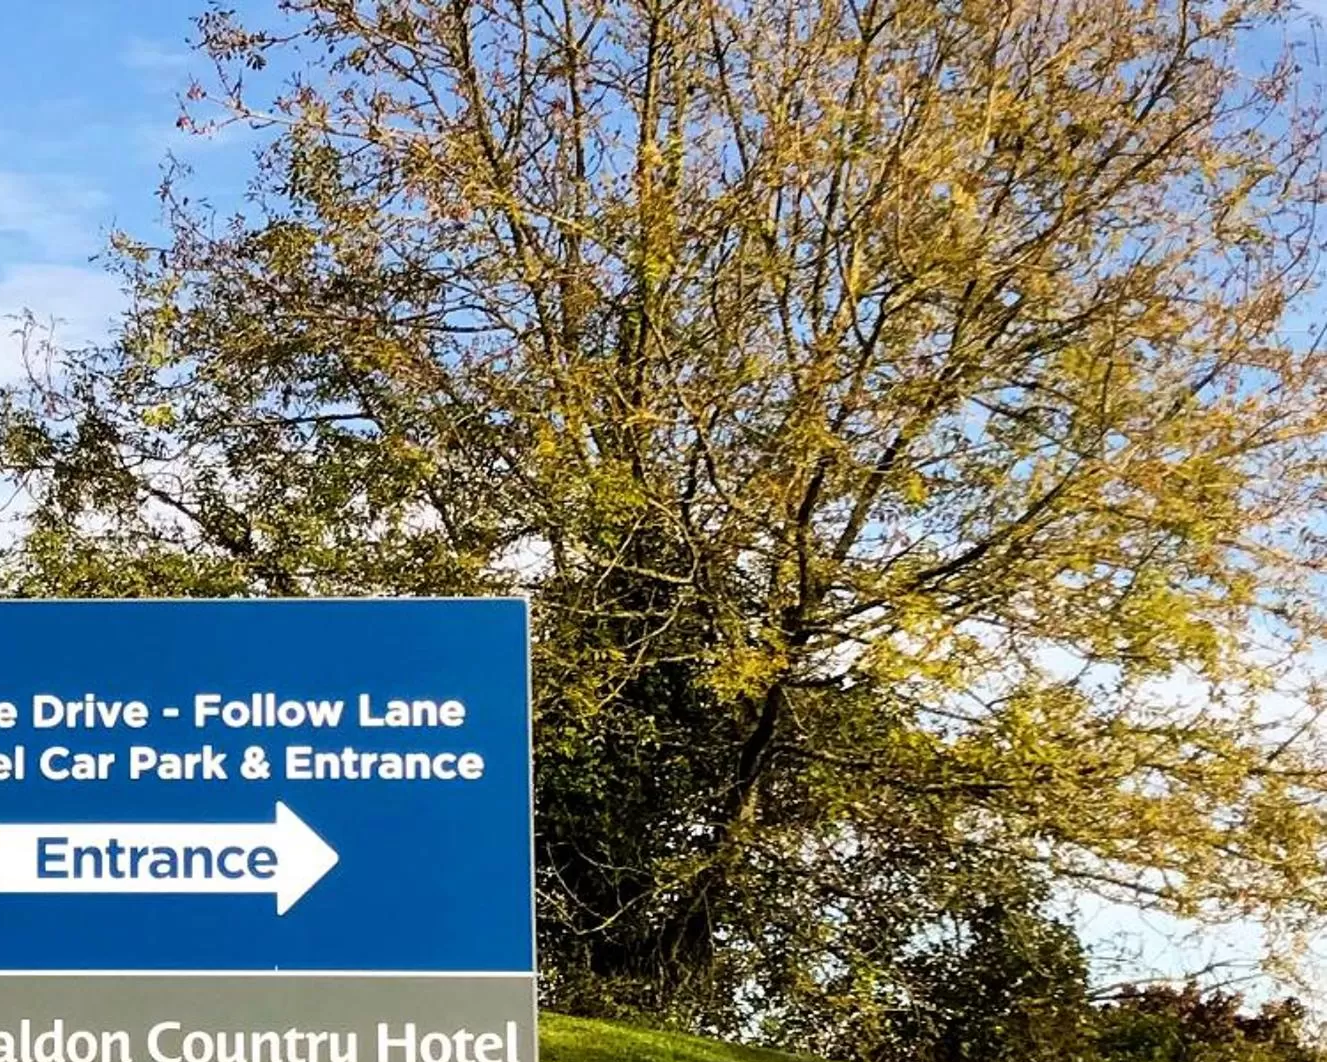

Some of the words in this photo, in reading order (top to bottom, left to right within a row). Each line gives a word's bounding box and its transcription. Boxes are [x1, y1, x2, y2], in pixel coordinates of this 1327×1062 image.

[34, 694, 148, 727] Drive
[196, 693, 343, 727] Follow
[360, 694, 465, 726] Lane
[40, 747, 114, 779] Car
[131, 746, 227, 779] Park
[241, 746, 270, 779] &
[287, 747, 484, 779] Entrance
[37, 837, 278, 879] Entrance
